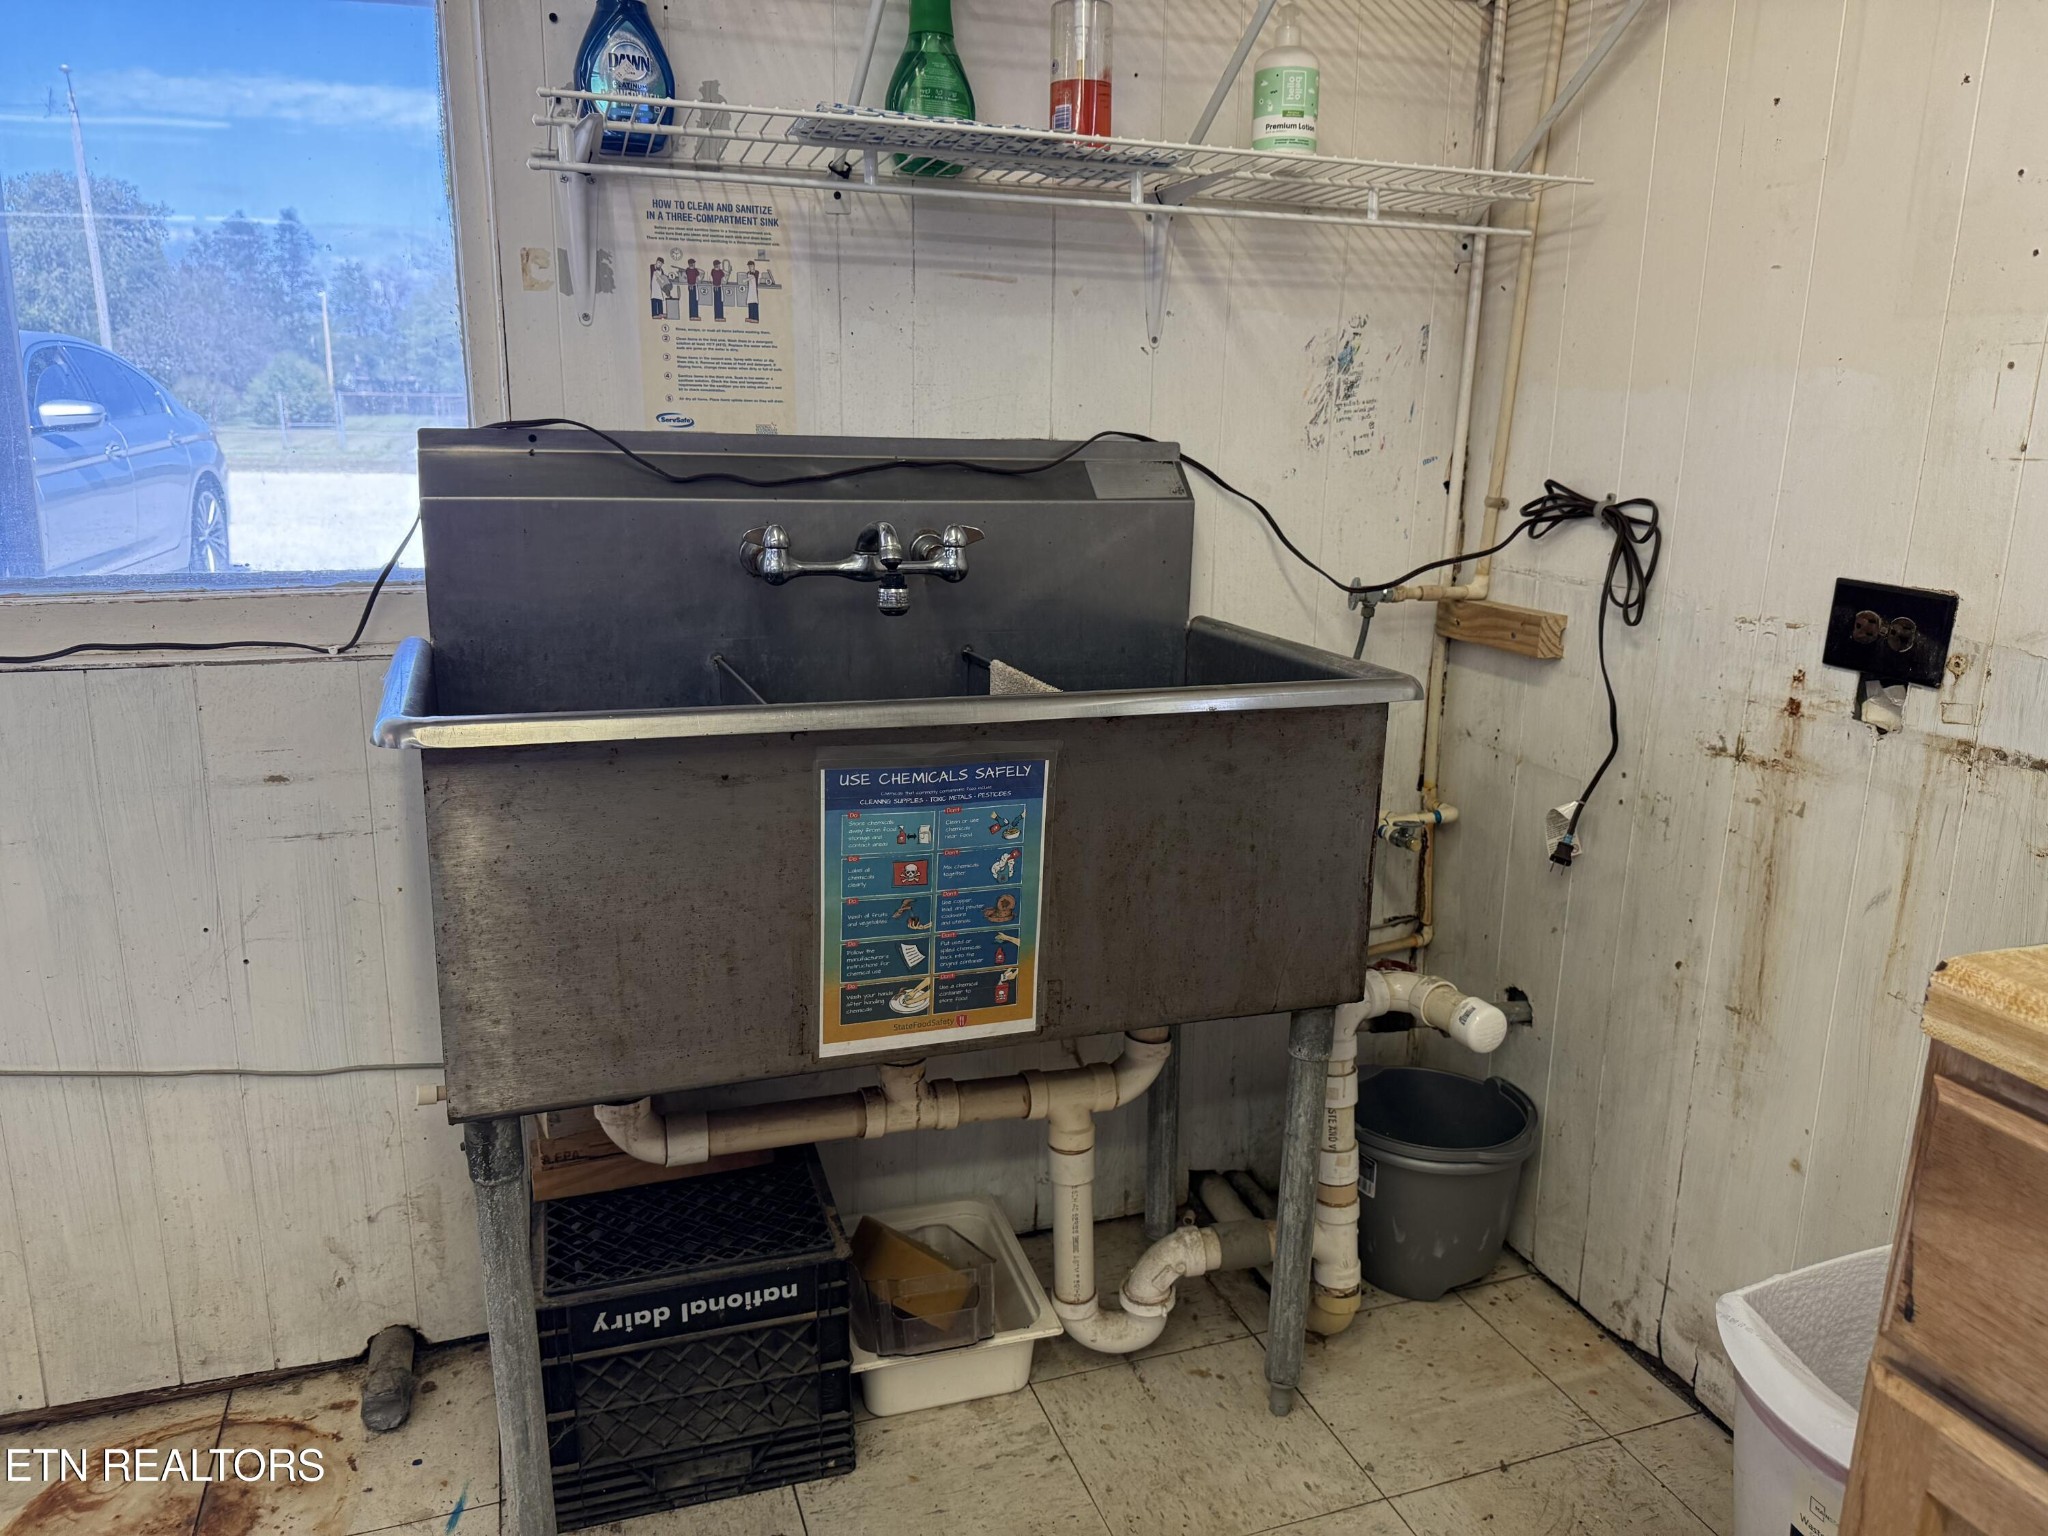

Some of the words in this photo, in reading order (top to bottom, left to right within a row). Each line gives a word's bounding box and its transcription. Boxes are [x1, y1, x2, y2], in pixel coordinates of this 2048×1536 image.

[608, 52, 650, 72] DAWN
[1265, 122, 1297, 131] Premium
[1298, 123, 1315, 132] Lotion
[652, 198, 672, 209] HOW
[674, 200, 685, 210] TO
[687, 201, 714, 212] CLEAN
[716, 203, 733, 213] AND
[735, 204, 773, 215] SANITIZE
[646, 210, 655, 220] IN
[657, 211, 664, 220] A
[666, 211, 758, 226] THREE-COMPARTMENT
[760, 217, 779, 228] SINK
[839, 773, 871, 786] USE
[879, 768, 968, 785] CHEMICALS
[975, 765, 1032, 780] SAFELY
[948, 793, 973, 801] METALS
[977, 790, 1012, 799] PESTICIDES
[893, 1018, 955, 1031] StateFoodSafety
[682, 1283, 798, 1323] national
[592, 1305, 670, 1333] dairy
